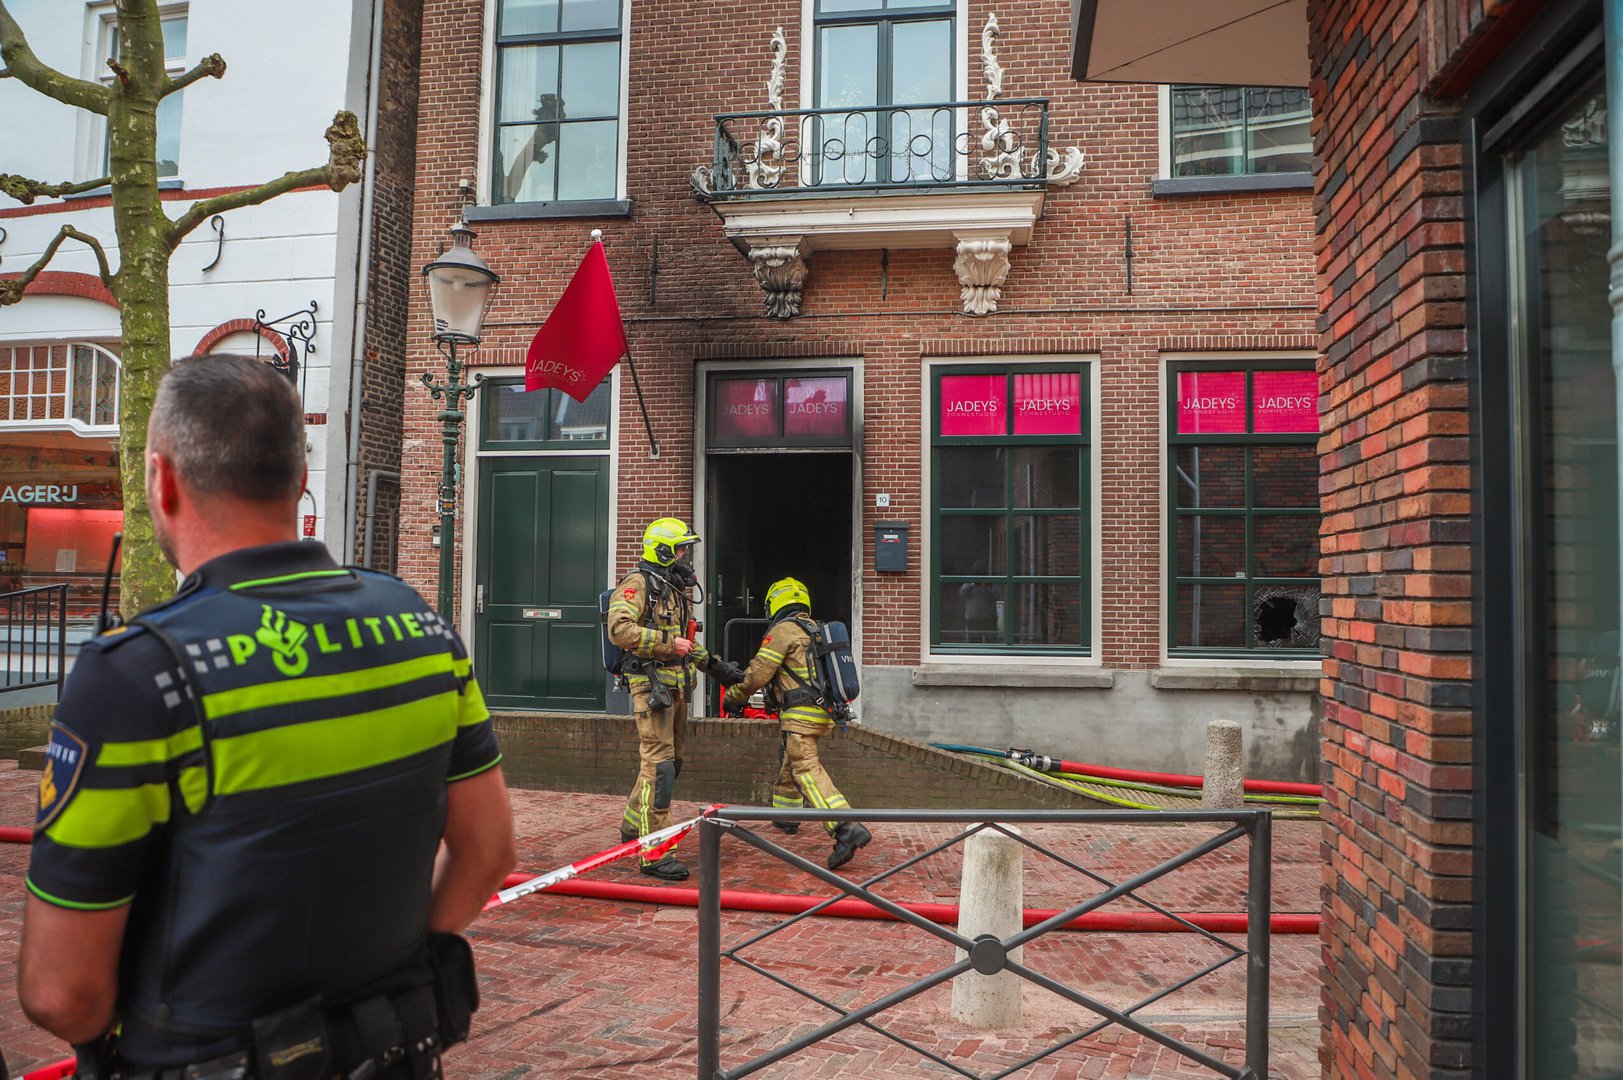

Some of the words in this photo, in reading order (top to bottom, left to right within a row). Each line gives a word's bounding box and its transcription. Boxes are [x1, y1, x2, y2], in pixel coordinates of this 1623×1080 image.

[529, 359, 582, 382] JADEYS
[790, 402, 838, 414] JADEYS
[947, 400, 997, 412] JADEYS
[1019, 399, 1070, 411] JADEYS
[1183, 397, 1236, 409] JADEYS
[1258, 396, 1312, 409] JADEYS
[879, 496, 888, 504] 10
[226, 604, 425, 677] POLITIE
